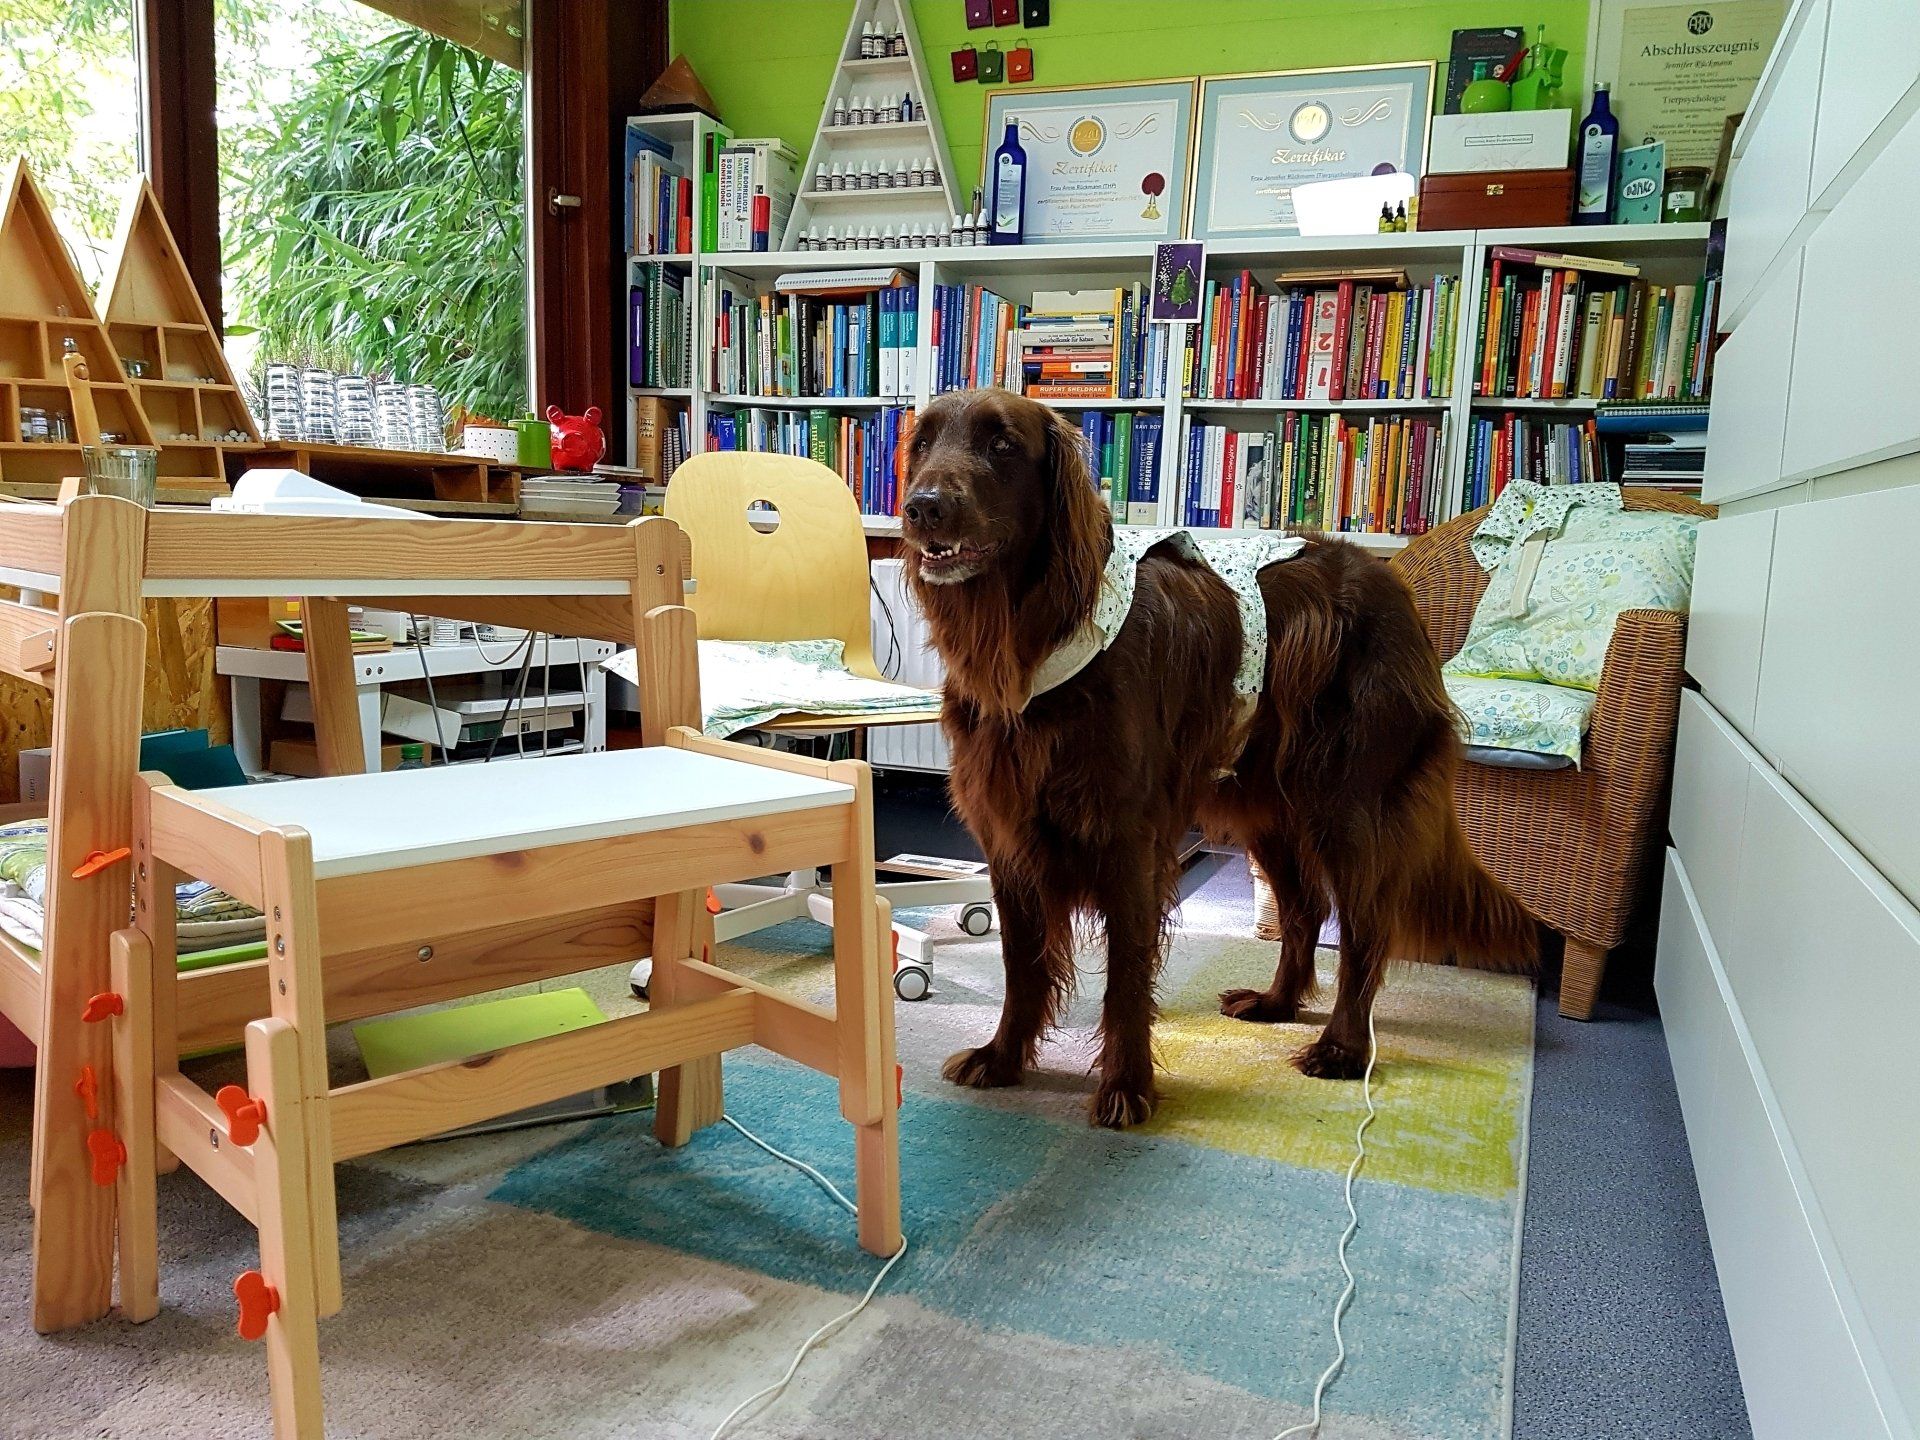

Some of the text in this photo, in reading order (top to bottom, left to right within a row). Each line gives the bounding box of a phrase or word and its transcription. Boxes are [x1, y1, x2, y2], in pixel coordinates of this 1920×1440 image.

[1641, 38, 1760, 57] Abschlusszeugnis
[1665, 61, 1693, 70] Jennifer
[1663, 94, 1727, 106] Tierpsychologie
[1271, 148, 1347, 167] Zertifikat
[1051, 160, 1118, 177] Zertifikat
[725, 158, 733, 207] BORRELIOSE
[742, 175, 750, 213] BORRELIOSE
[1320, 301, 1336, 320] 3
[1514, 293, 1523, 314] CHINESE
[1131, 315, 1139, 338] Agility
[1318, 332, 1333, 351] 2
[1401, 322, 1410, 372] WELPENTRAINING
[905, 350, 911, 358] 2
[1266, 345, 1274, 365] Welpen
[1558, 347, 1566, 367] MENSCH
[1317, 368, 1328, 387] 1
[1311, 441, 1319, 455] geht
[1373, 432, 1381, 457] HUNDES
[1138, 442, 1147, 491] PRAKTISCHES
[1144, 441, 1154, 491] REPERTORIUM
